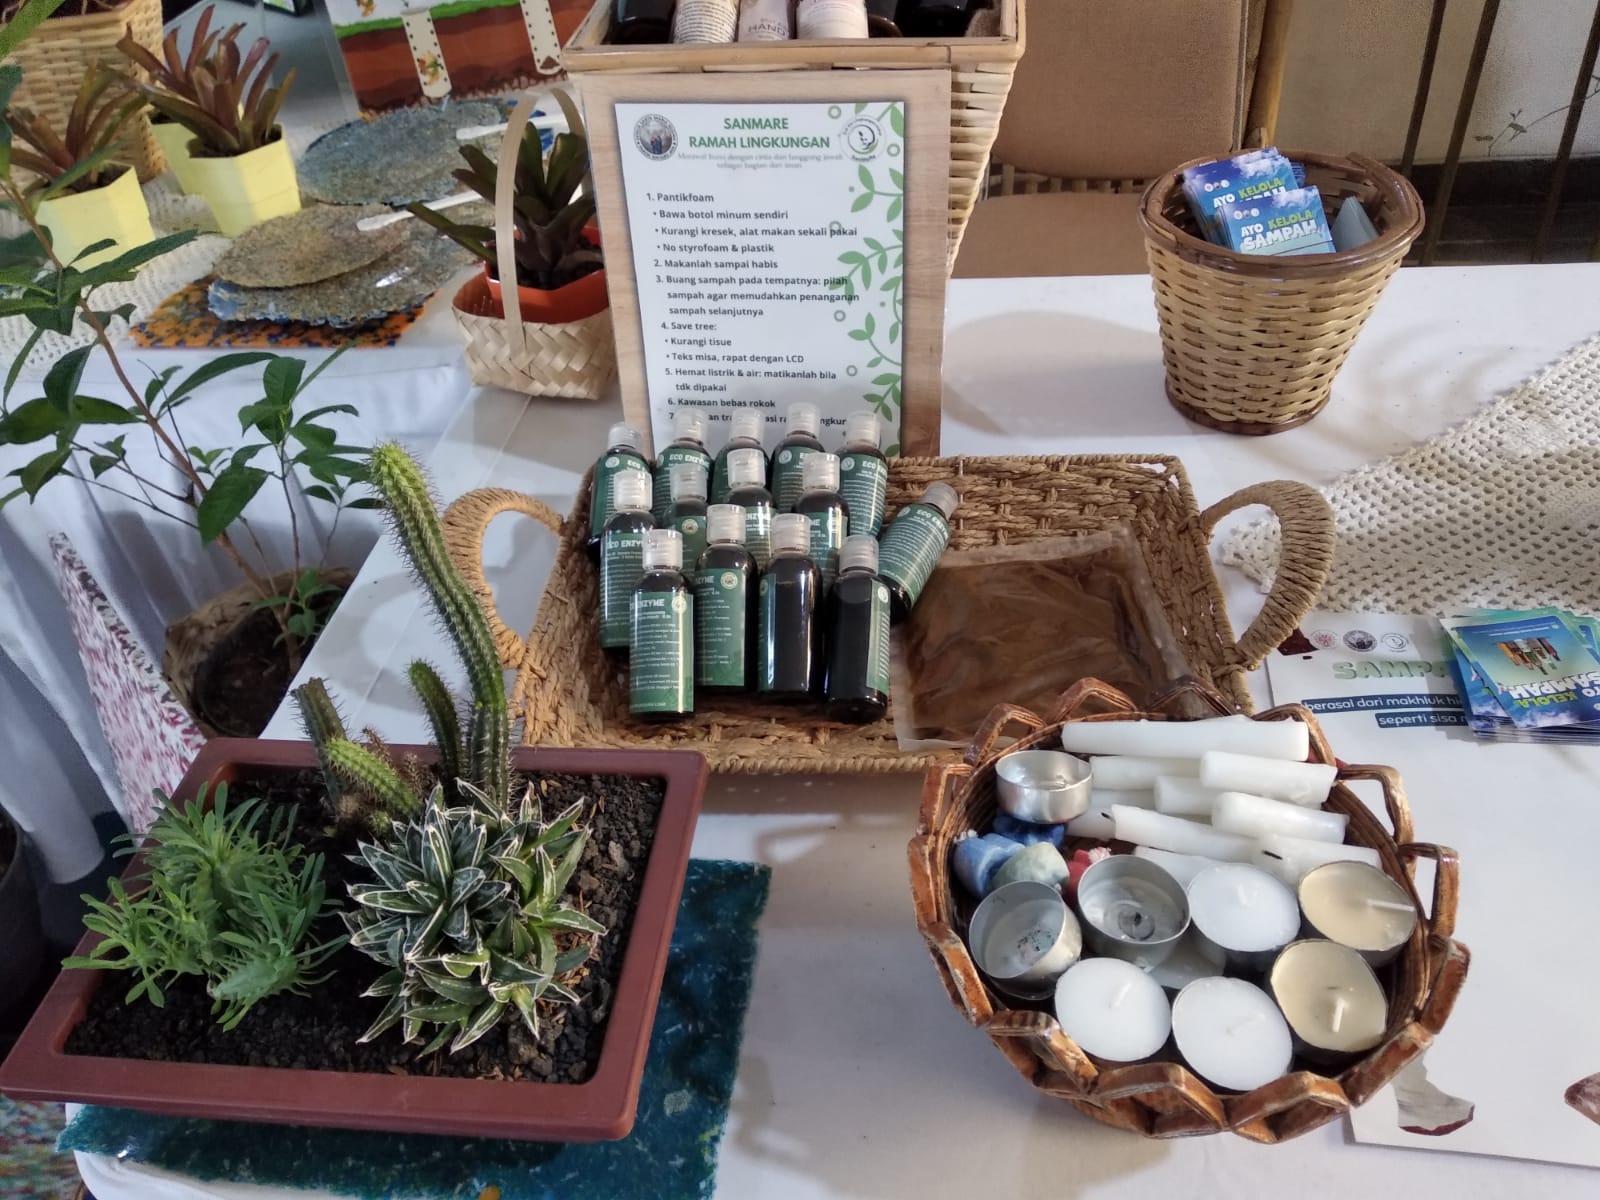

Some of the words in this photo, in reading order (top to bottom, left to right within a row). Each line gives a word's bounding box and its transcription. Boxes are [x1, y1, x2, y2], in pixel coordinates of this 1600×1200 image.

[723, 117, 789, 130] SANMARE
[689, 136, 737, 149] RAMAH
[739, 136, 830, 149] LINGKUNGAN
[646, 192, 655, 202] 1.
[656, 192, 715, 202] Pantikfoam
[1213, 193, 1236, 208] AYO
[1237, 177, 1283, 199] KELOLA
[659, 210, 686, 219] Bawa
[688, 210, 714, 219] botol
[716, 210, 752, 220] minum
[753, 210, 788, 220] sendiri
[1241, 223, 1264, 237] AYO
[1267, 209, 1313, 230] KELOLA
[661, 226, 699, 238] Kurangi
[700, 227, 737, 238] kresek,
[738, 227, 759, 236] alat
[760, 227, 796, 237] makan
[798, 227, 827, 237] sekali
[829, 227, 858, 238] pakai
[1242, 219, 1317, 251] SAMPAH
[662, 243, 676, 252] No
[678, 243, 729, 254] styrofoam
[731, 244, 739, 253] &
[740, 243, 774, 255] plastik
[654, 259, 662, 268] 2.
[664, 259, 712, 268] Makanlah
[714, 260, 750, 270] sampai
[751, 260, 778, 269] habis
[655, 275, 664, 284] 3.
[666, 275, 697, 286] Buang
[698, 276, 737, 286] sampah
[739, 276, 763, 286] pada
[764, 276, 822, 287] tempatnya:
[823, 277, 848, 287] pilah
[667, 291, 705, 301] sampah
[707, 292, 728, 302] agar
[730, 292, 797, 302] memudahkan
[799, 293, 860, 303] penanganan
[669, 307, 706, 317] sampah
[708, 307, 764, 317] selanjutnya
[661, 322, 669, 330] 4.
[671, 322, 696, 331] Save
[697, 322, 718, 331] tree:
[670, 337, 707, 347] Kurangi
[708, 338, 732, 346] tisue
[671, 352, 694, 362] Teks
[695, 353, 721, 363] misa,
[721, 354, 748, 364] rapat
[749, 353, 784, 364] dengan
[786, 355, 804, 363] LCD
[665, 367, 673, 376] 5.
[675, 368, 706, 377] Hemat
[708, 368, 736, 378] listrik
[737, 369, 744, 377] &
[746, 369, 762, 378] air:
[763, 369, 818, 379] matikanlah
[819, 370, 837, 380] bila
[675, 383, 691, 392] tdk
[692, 383, 727, 393] dipakai
[668, 398, 676, 406] 6.
[677, 398, 718, 407] Kawasan
[719, 399, 747, 408] bebas
[748, 399, 776, 408] rokok
[862, 460, 877, 469] ECO
[1332, 660, 1450, 680] SAMPA
[1304, 701, 1355, 711] berasal
[1356, 698, 1384, 709] dari
[1386, 695, 1445, 707] makhluk
[1378, 714, 1428, 726] seperti
[1429, 712, 1458, 724] sisa
